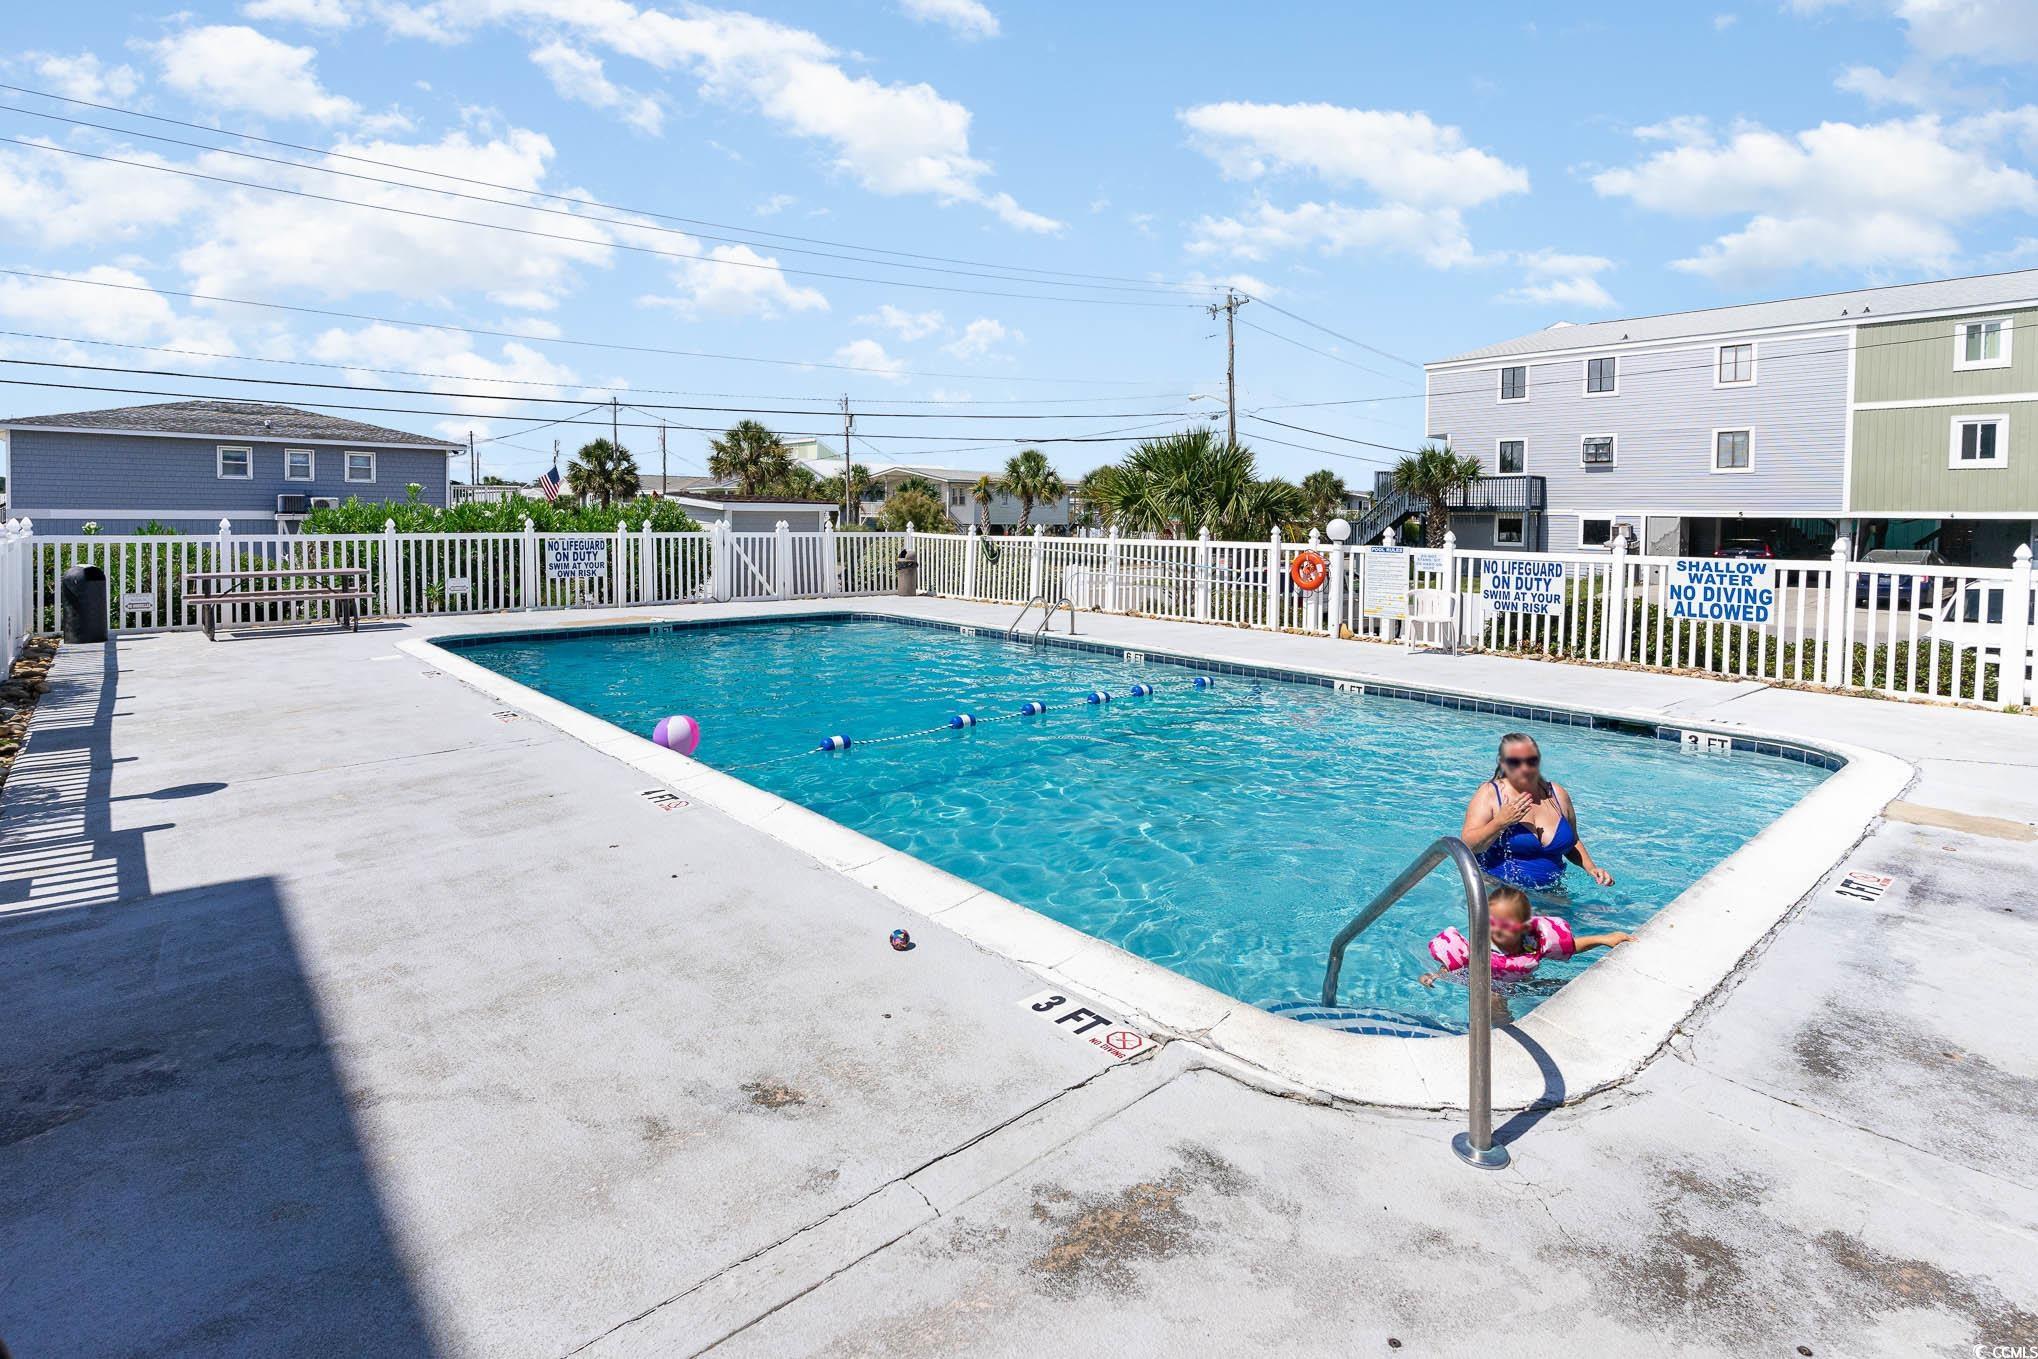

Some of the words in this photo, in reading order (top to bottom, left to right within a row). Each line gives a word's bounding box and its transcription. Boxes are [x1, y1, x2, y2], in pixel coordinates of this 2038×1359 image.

[548, 541, 559, 551] NO
[562, 541, 605, 551] LIFEGUARD
[555, 552, 569, 562] ON
[573, 551, 598, 561] DUTY
[549, 562, 569, 570] SWIM
[1483, 560, 1498, 574] NO
[1502, 561, 1562, 577] LIFEGUARD
[1677, 560, 1766, 574] SHALLOW
[1492, 575, 1510, 589] ON
[1515, 576, 1552, 592] DUTY
[1688, 573, 1753, 586] WATER
[1483, 589, 1510, 600] SWIM
[1514, 592, 1527, 601] AT
[1531, 592, 1561, 604] YOUR
[1670, 585, 1696, 600] NO
[1703, 587, 1773, 605] DIVING
[1494, 601, 1518, 611] OWN
[1522, 603, 1548, 613] RISK
[1673, 601, 1768, 622] ALLOWED
[1708, 738, 1729, 748] FT
[1840, 879, 1883, 895] FT
[1835, 890, 1875, 901] 3
[1032, 996, 1066, 1012] 3
[1054, 1008, 1113, 1035] FT
[1100, 1044, 1126, 1059] DIVING
